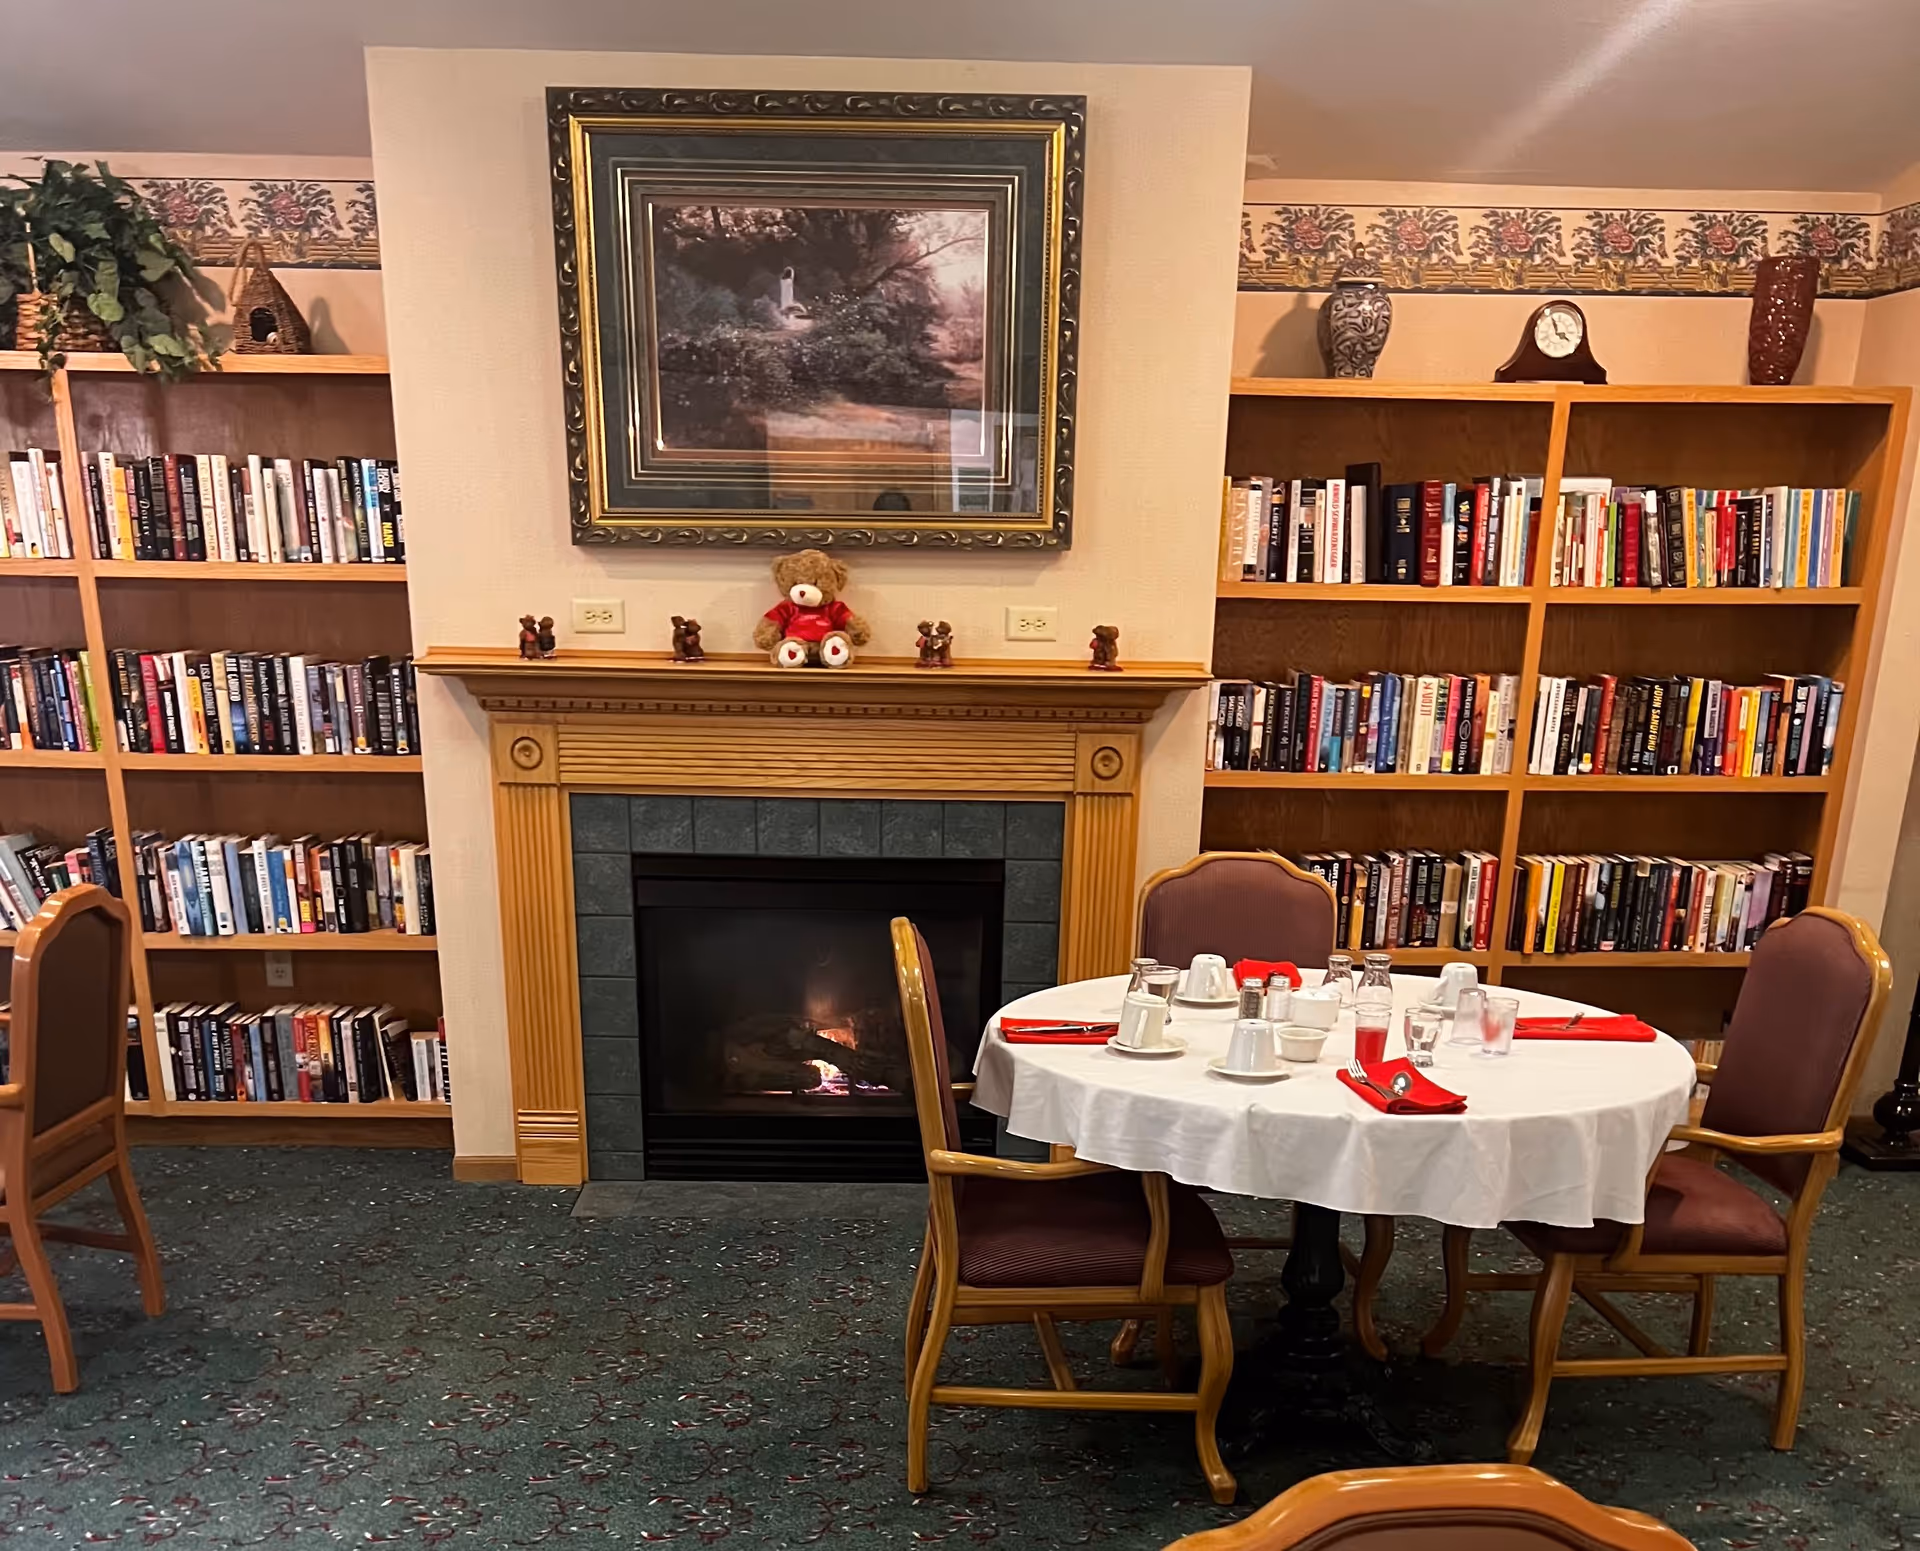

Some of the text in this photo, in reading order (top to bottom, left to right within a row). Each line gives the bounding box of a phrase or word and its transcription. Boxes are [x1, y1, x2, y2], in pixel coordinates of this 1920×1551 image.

[1270, 506, 1280, 546] LIBERTY
[1330, 483, 1340, 568] ARNOLD SCHWARZENEGGER
[199, 663, 210, 680] LISA
[258, 661, 272, 717] Elizabeth George
[202, 681, 216, 716] GARDNER
[1651, 685, 1663, 707] JOHN
[1309, 698, 1318, 730] PICOULT
[1647, 708, 1660, 751] SANDFORD
[199, 866, 211, 893] JAMES
